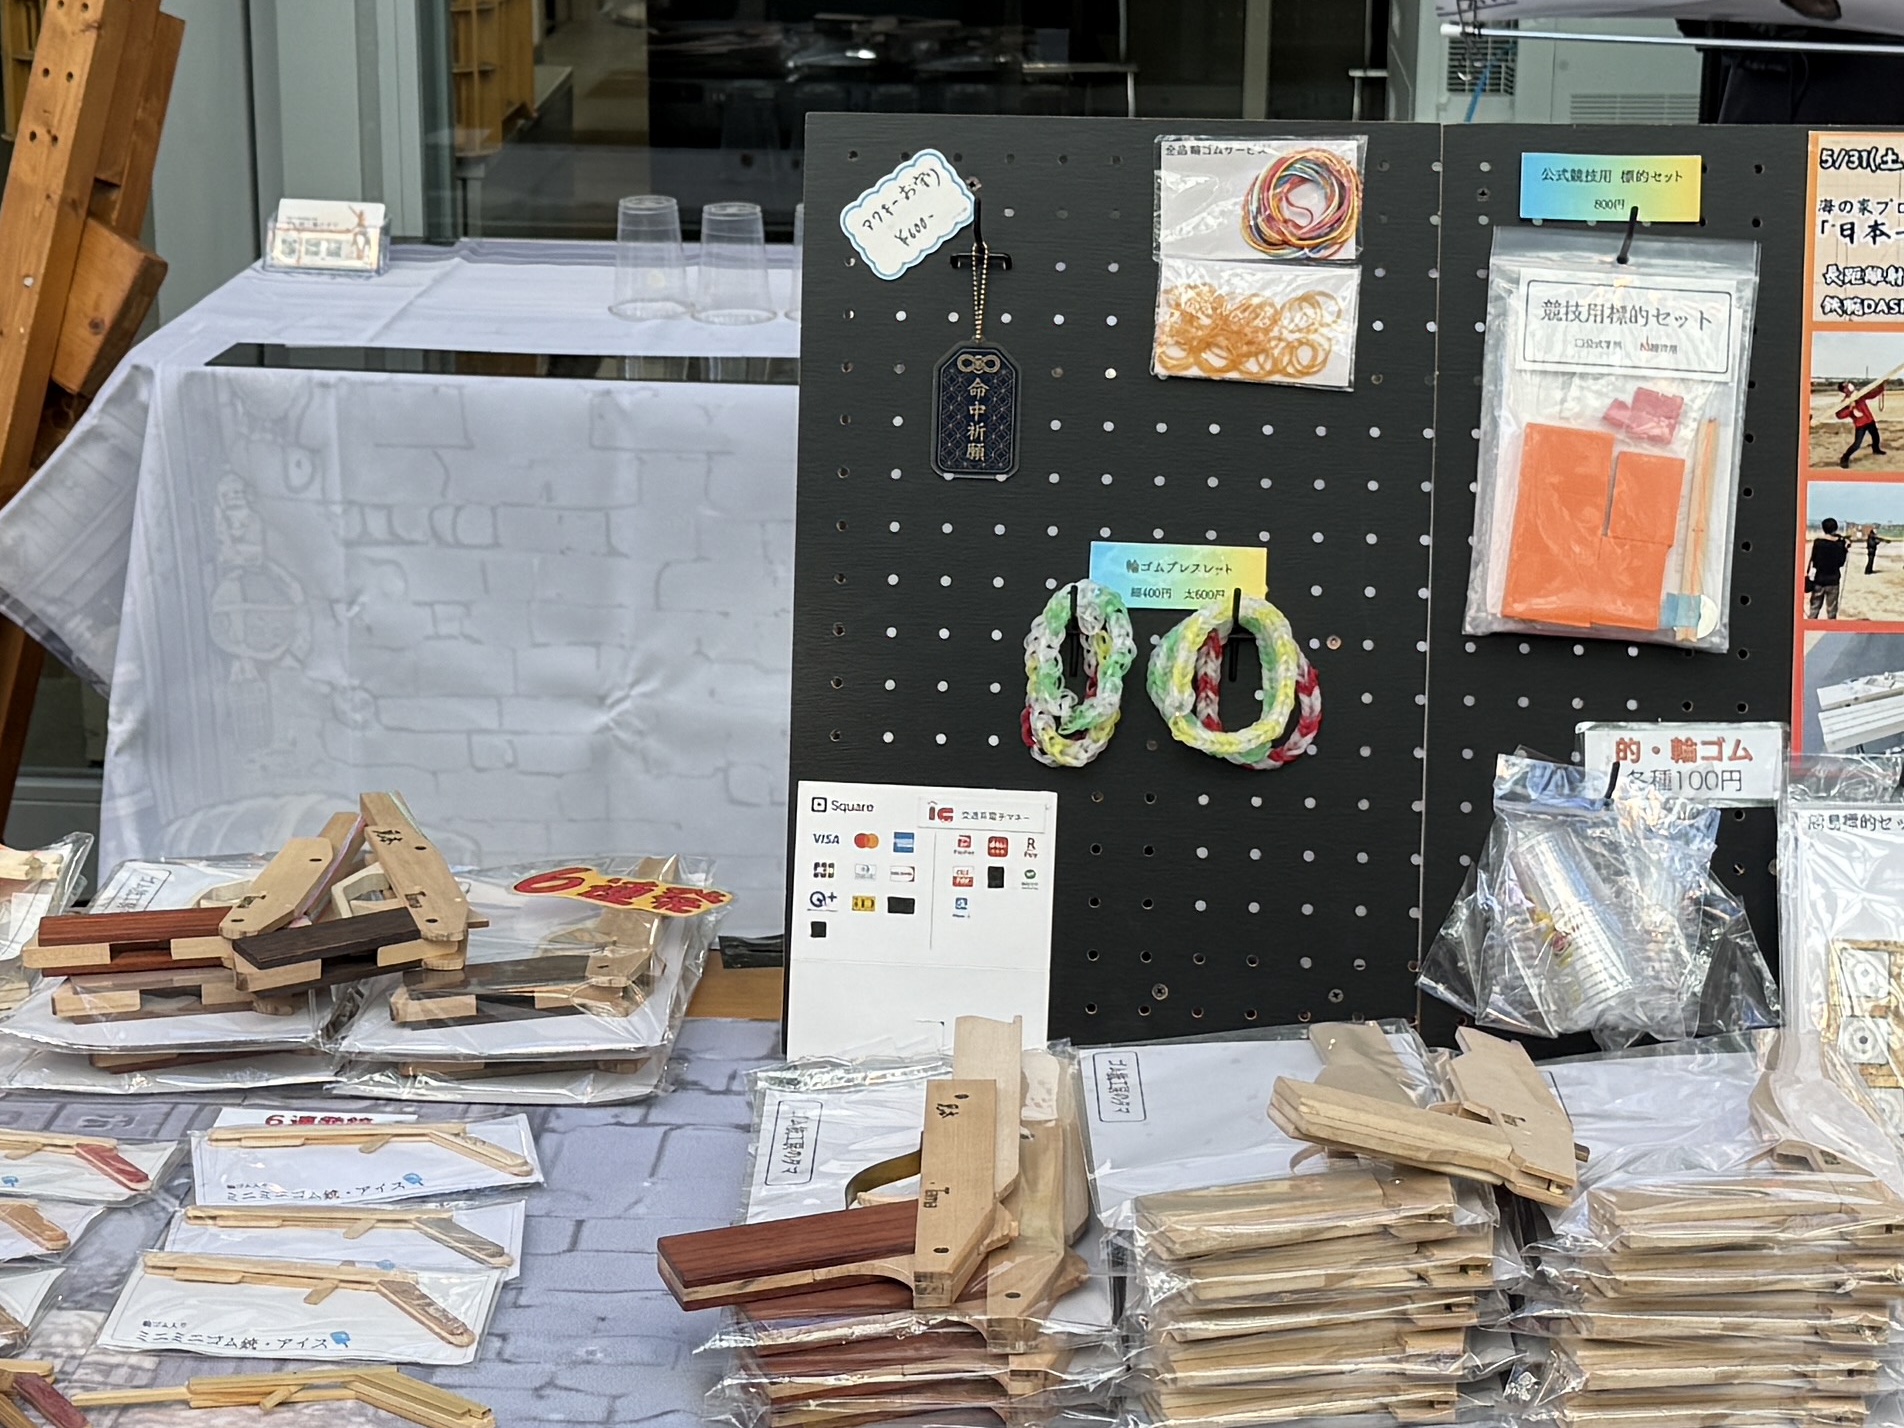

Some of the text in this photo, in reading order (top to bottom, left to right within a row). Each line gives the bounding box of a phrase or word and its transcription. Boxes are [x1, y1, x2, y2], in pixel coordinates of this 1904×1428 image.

[1540, 167, 1684, 184] 公式競技用 標的セット
[1540, 299, 1713, 332] 競技用標的セット
[964, 376, 990, 462] 命中祈願
[1614, 736, 1755, 765] 的・輪ゴム
[830, 799, 875, 814] Square
[813, 833, 841, 845] VISA
[136, 1330, 328, 1351] ミニミニゴム銃・アイス
